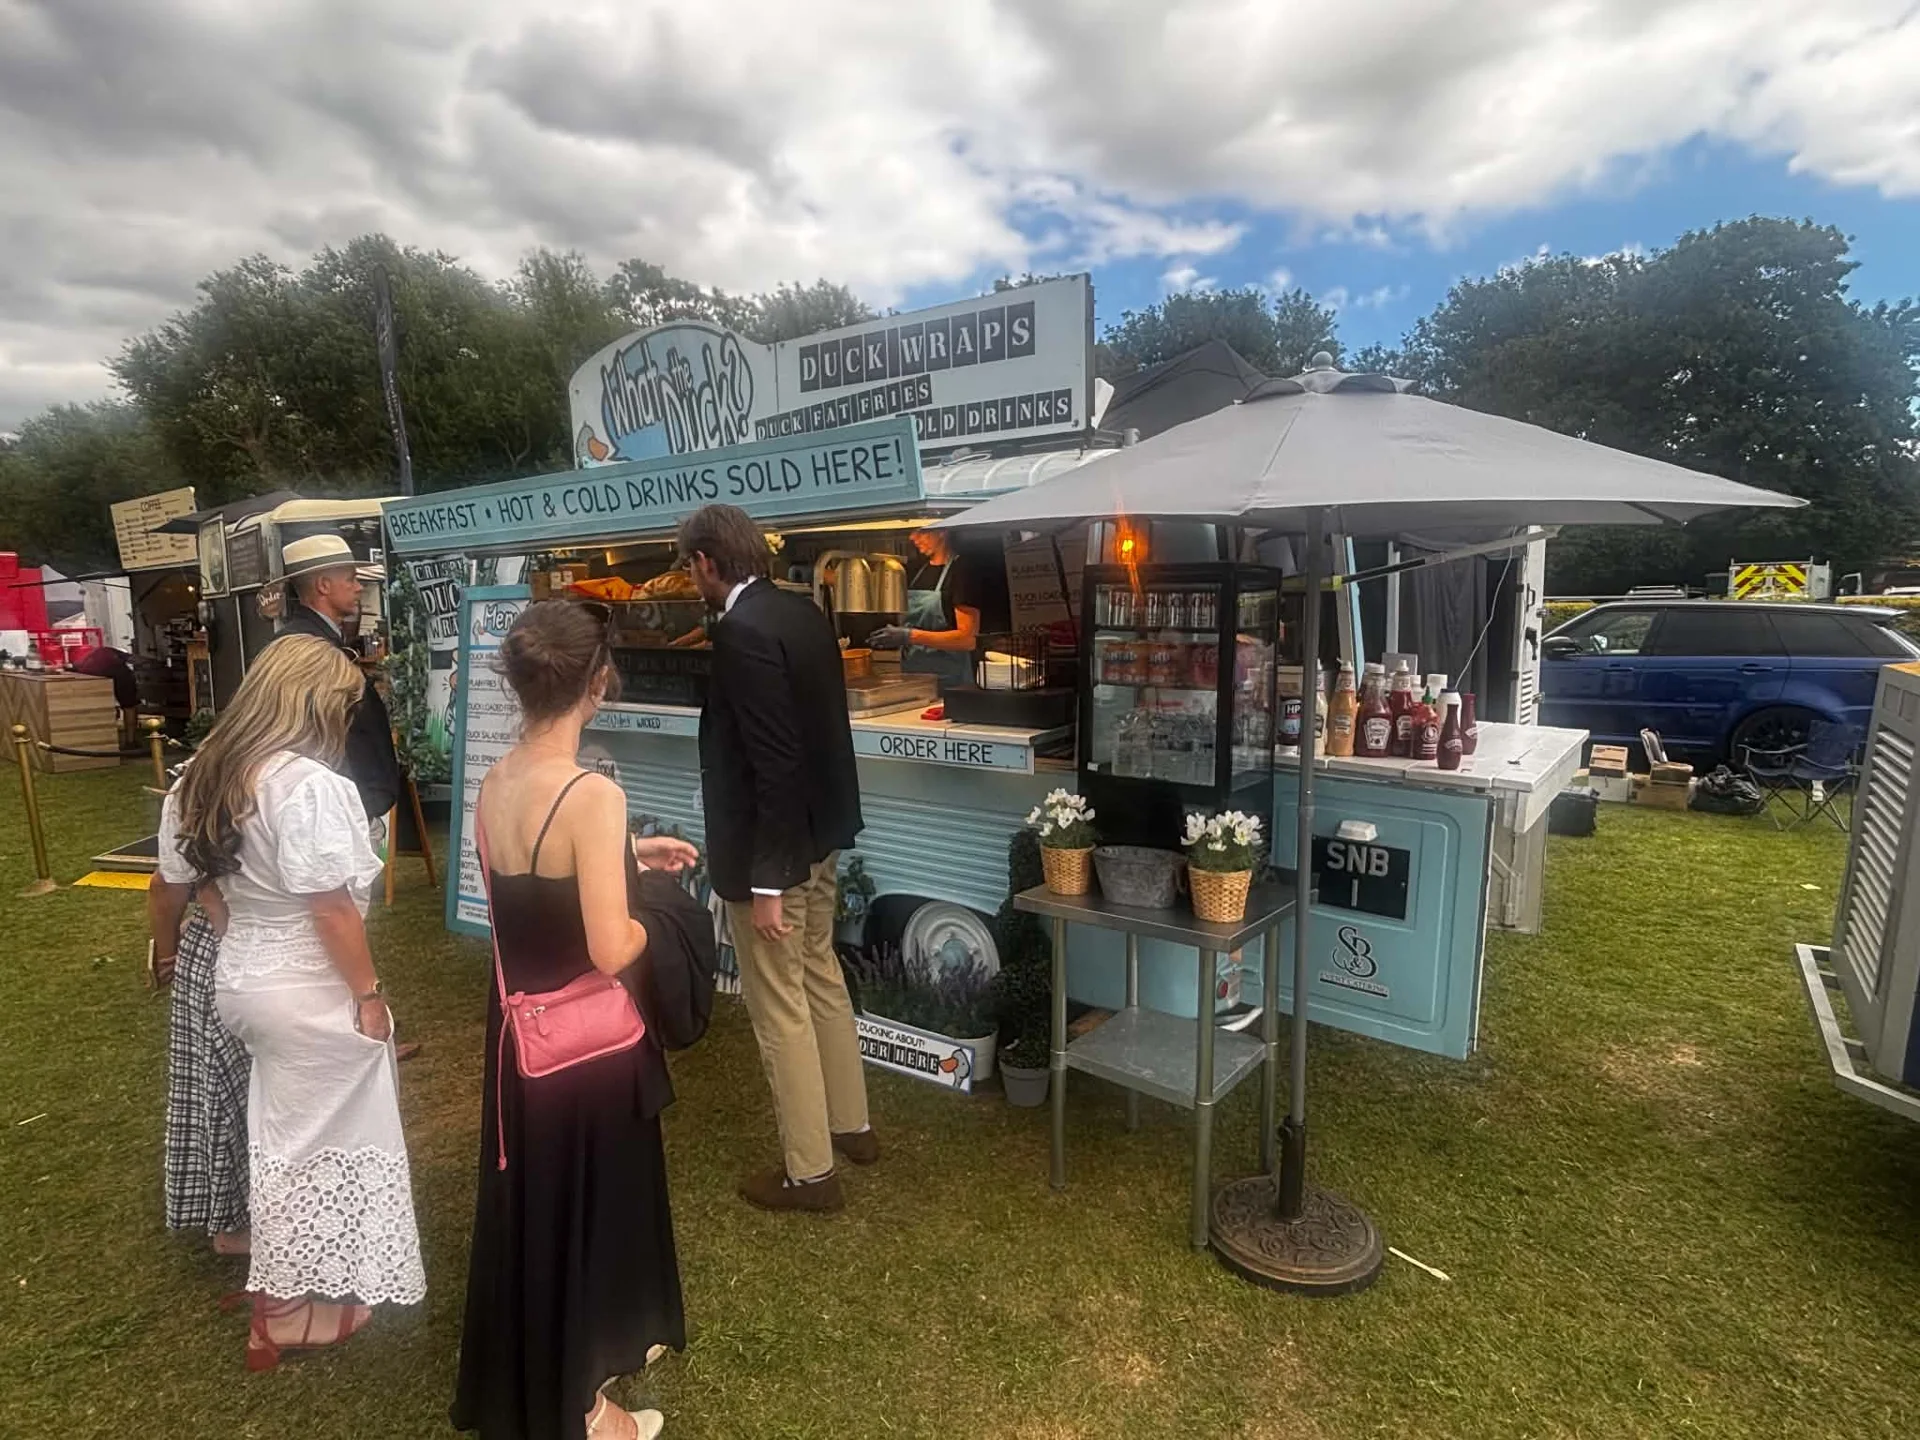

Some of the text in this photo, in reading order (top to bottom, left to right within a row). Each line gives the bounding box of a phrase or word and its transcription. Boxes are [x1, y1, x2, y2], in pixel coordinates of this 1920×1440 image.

[666, 347, 694, 397] the
[802, 316, 1030, 381] DUCK WRAPS
[601, 338, 664, 440] What
[756, 382, 929, 441] DUCK FAT FRIES
[915, 396, 1069, 433] OLD DRINKS
[389, 438, 905, 537] BREAKFAST HOT & COLD DRINKS SOLD HERE!
[420, 582, 460, 614] DUC
[880, 735, 993, 764] ORDER HERE
[1326, 841, 1390, 877] SNB
